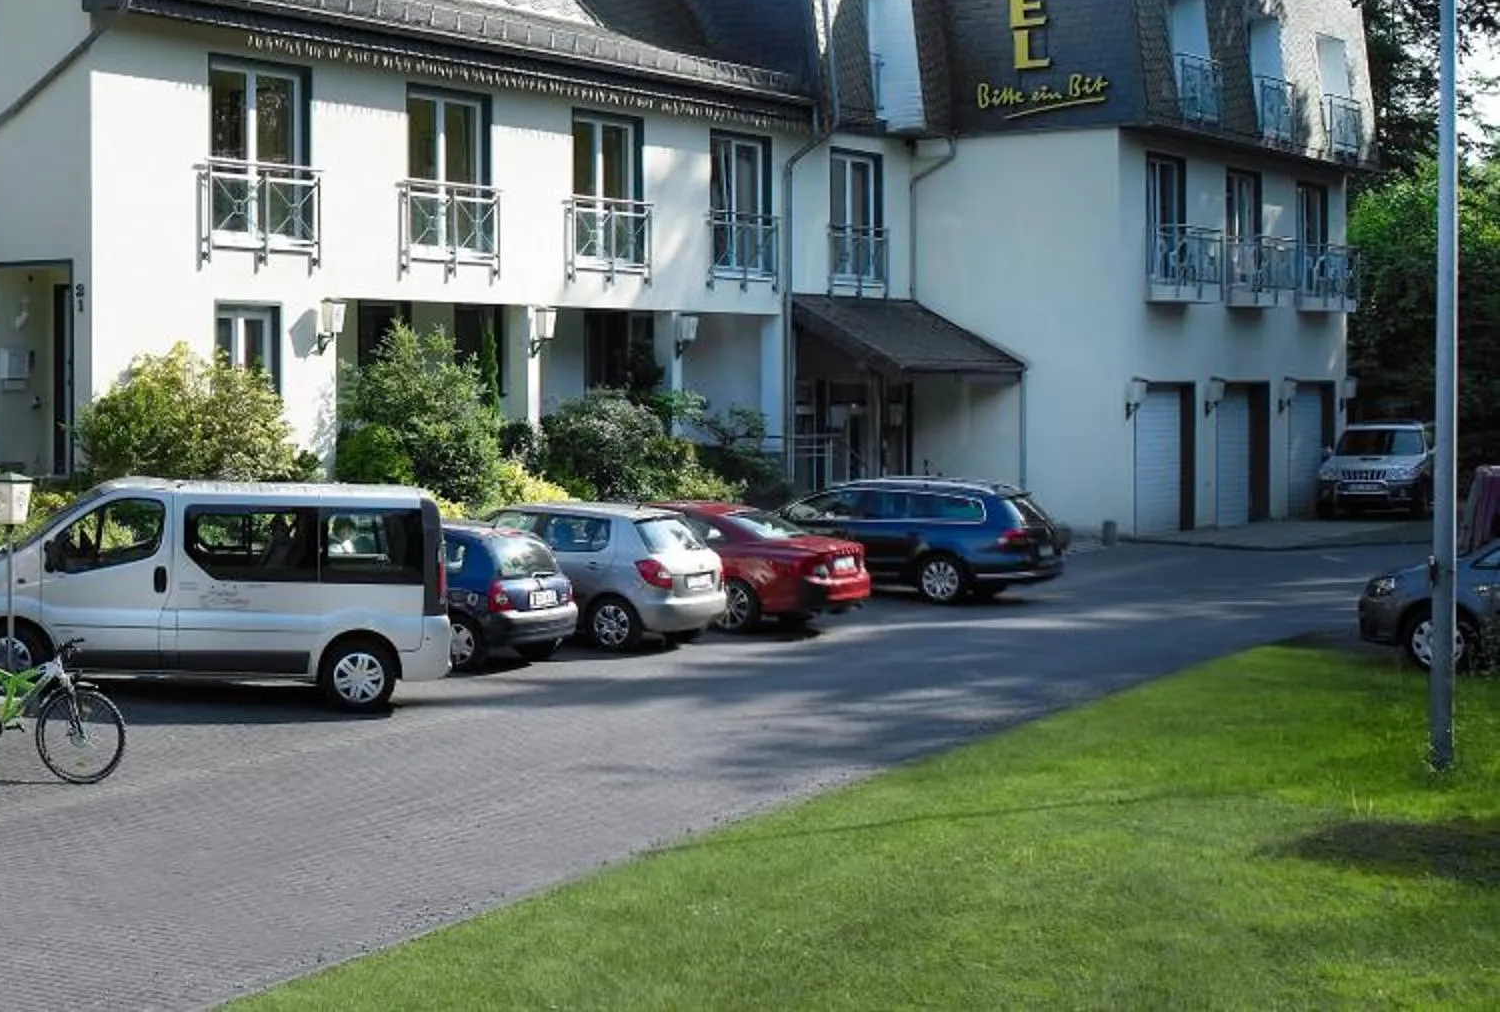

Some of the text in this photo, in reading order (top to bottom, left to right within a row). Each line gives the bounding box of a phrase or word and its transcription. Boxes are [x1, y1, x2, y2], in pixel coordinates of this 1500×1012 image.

[978, 73, 1109, 109] Bitte ein Bit
